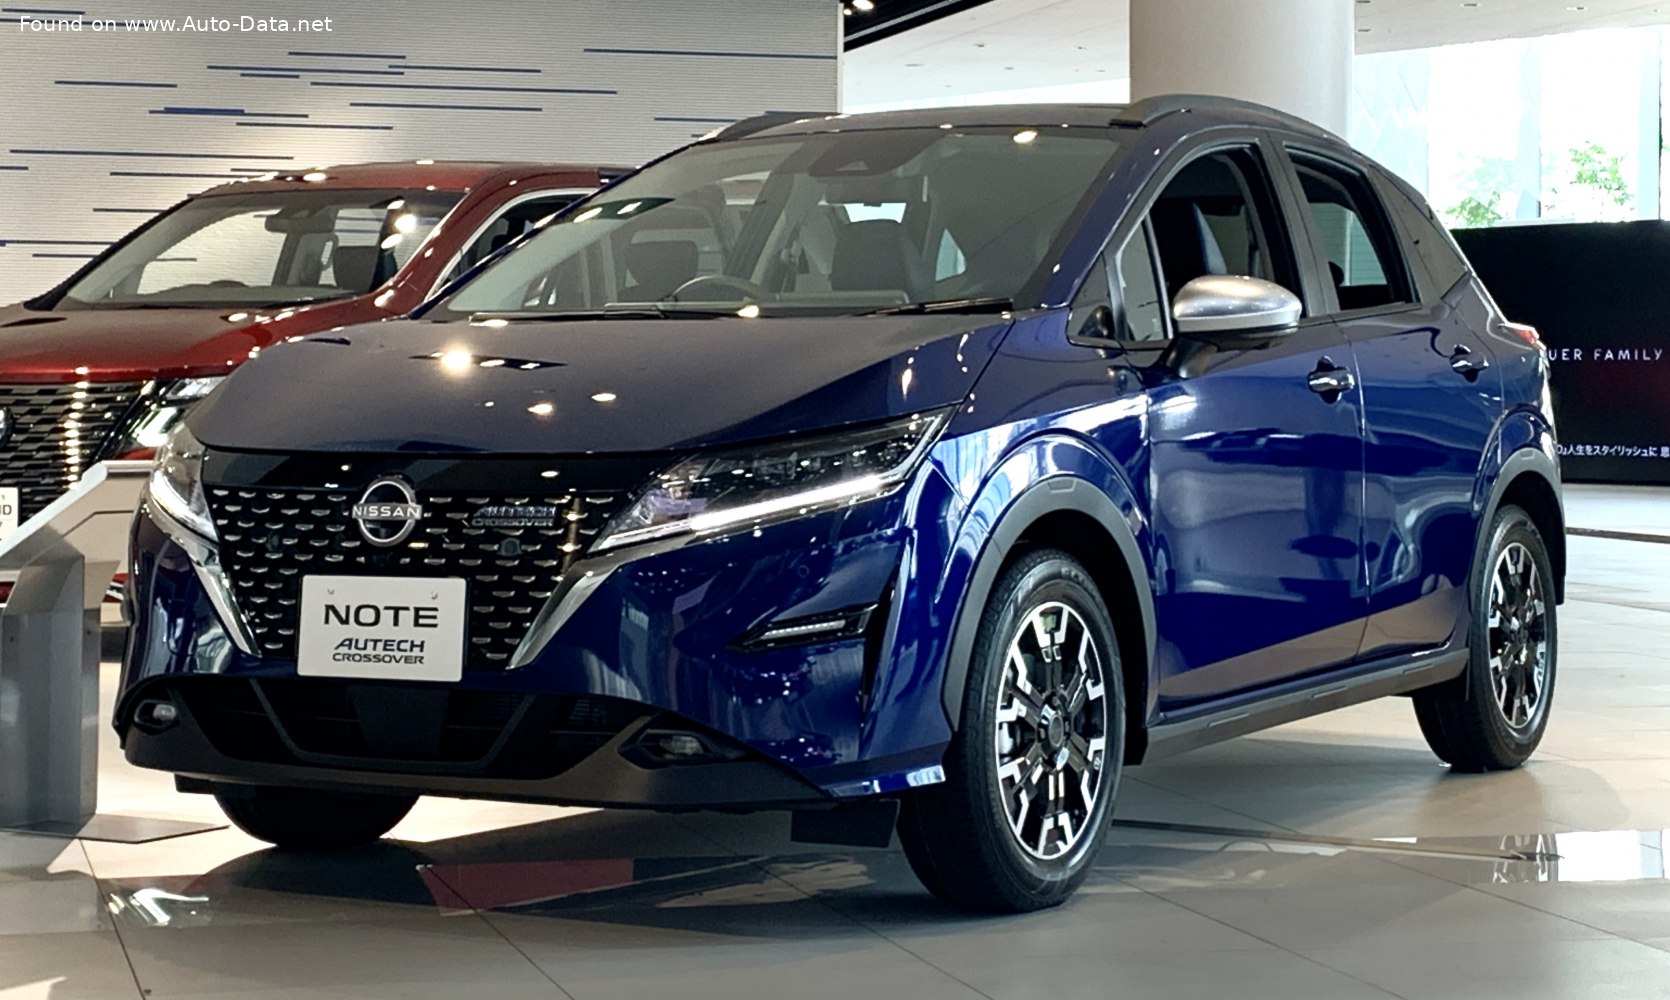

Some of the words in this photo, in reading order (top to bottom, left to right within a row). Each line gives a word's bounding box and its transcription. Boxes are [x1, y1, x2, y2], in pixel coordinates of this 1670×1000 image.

[1593, 348, 1663, 361] FAMILY
[353, 505, 420, 518] NISSAN
[324, 603, 440, 628] NOTE
[334, 638, 426, 653] AUTECH
[332, 652, 425, 665] CROSSOVER
